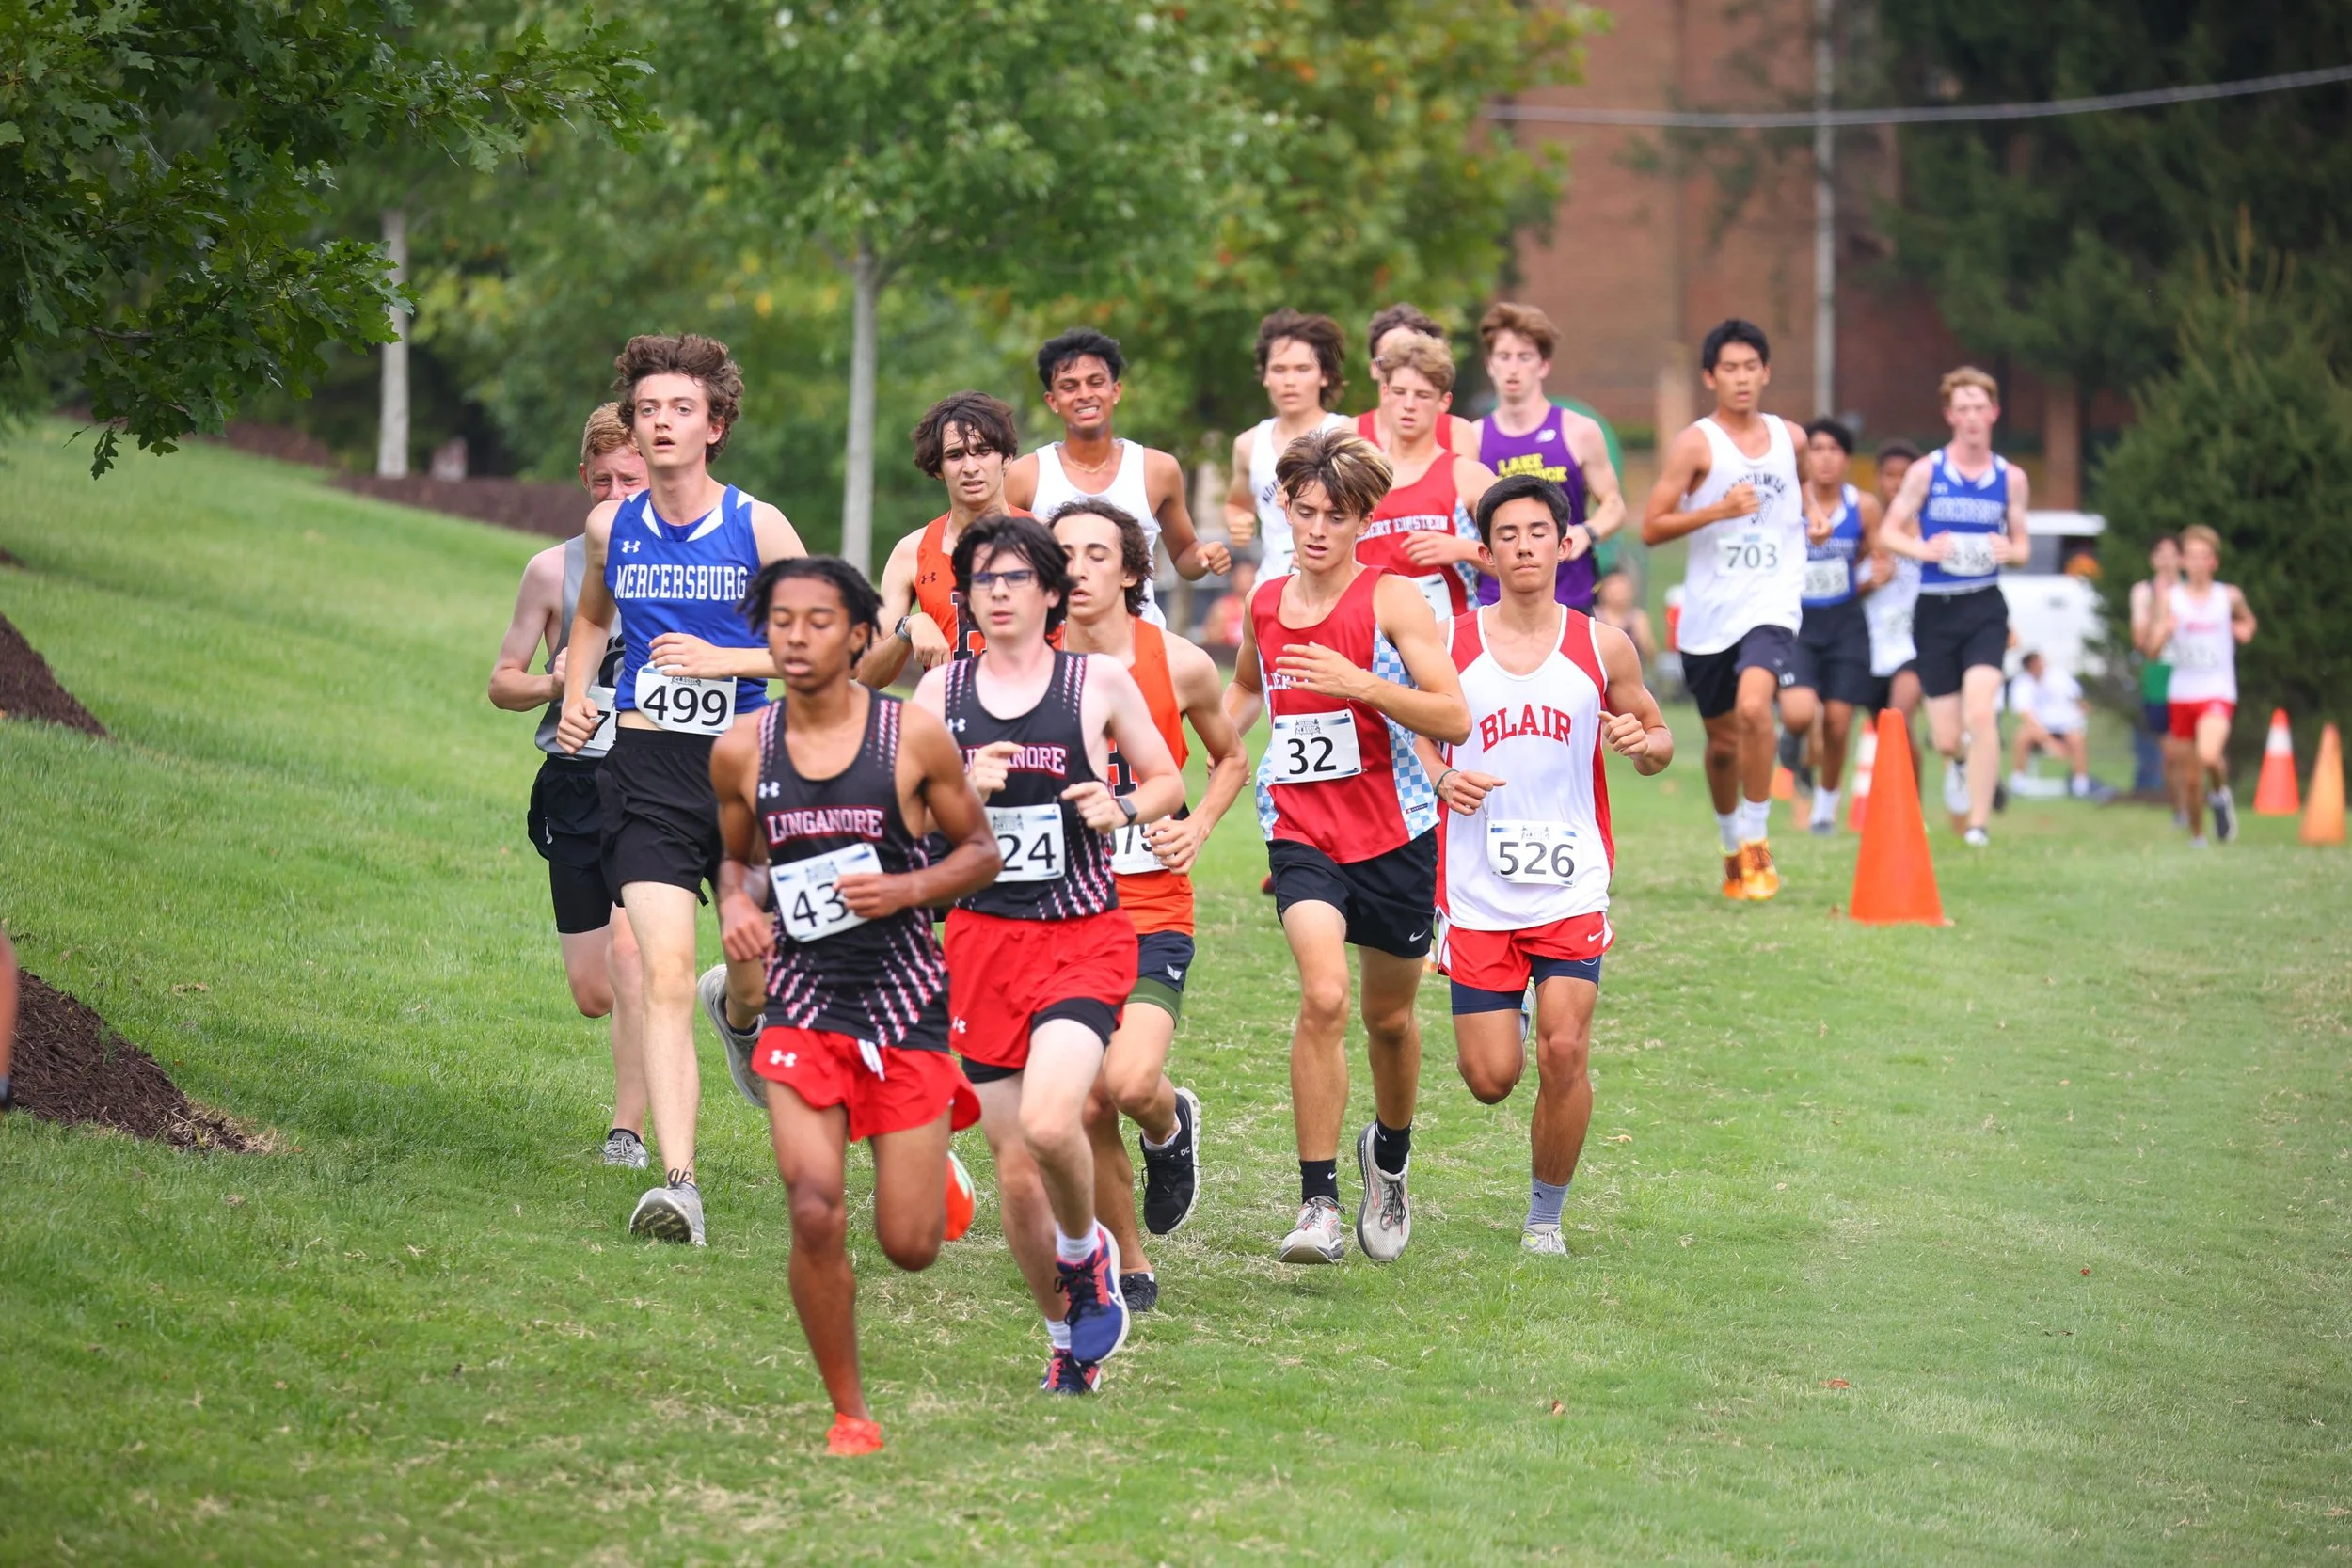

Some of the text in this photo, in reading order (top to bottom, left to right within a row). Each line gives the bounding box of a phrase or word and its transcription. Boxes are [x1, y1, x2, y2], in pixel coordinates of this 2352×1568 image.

[1393, 515, 1448, 533] EINSTEIN
[1726, 544, 1777, 569] 703
[614, 564, 748, 601] MERCERSBURG
[643, 685, 728, 727] 499
[1480, 704, 1571, 752] BLAIR
[1287, 736, 1337, 775] 32
[767, 809, 883, 846] LINGANORE
[1500, 842, 1575, 878] 526
